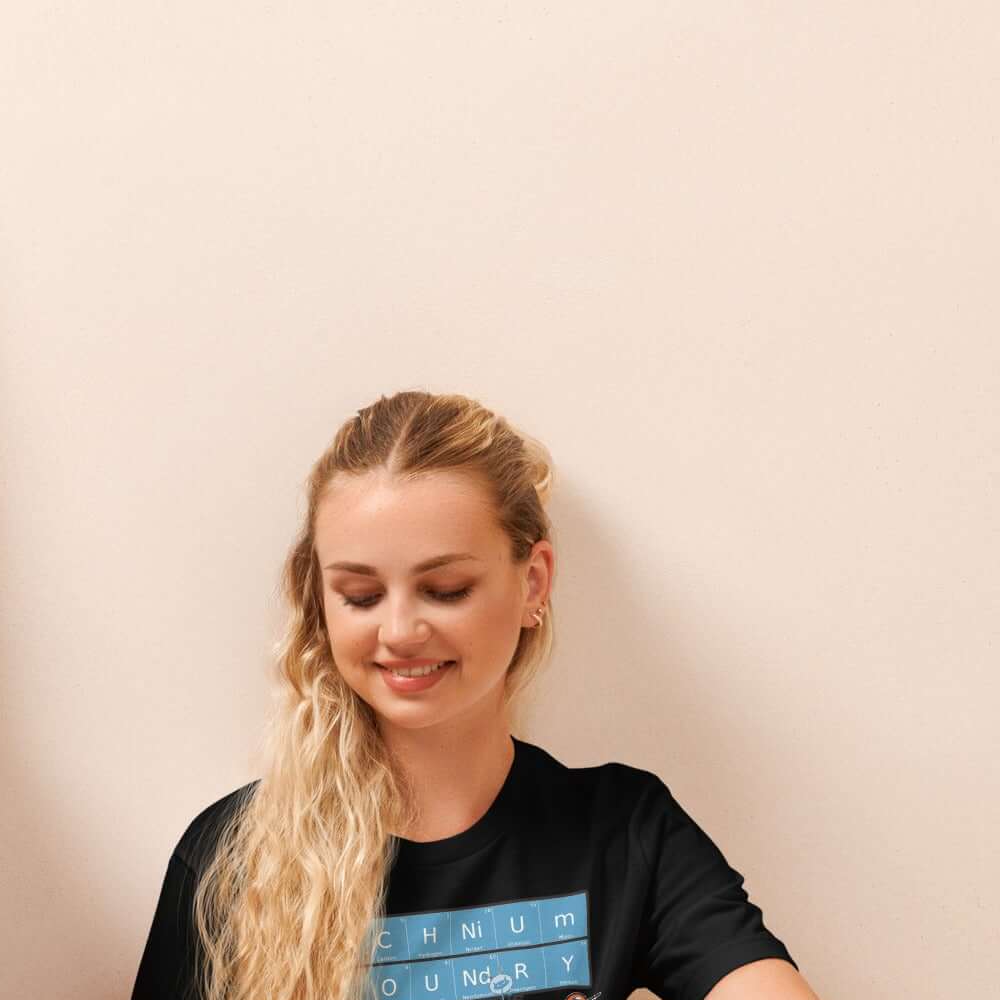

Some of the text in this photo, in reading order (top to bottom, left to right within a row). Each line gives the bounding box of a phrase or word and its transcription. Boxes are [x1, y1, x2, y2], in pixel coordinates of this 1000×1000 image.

[377, 911, 575, 949] C H Ni U m
[381, 954, 575, 997] O U Nd R Y
